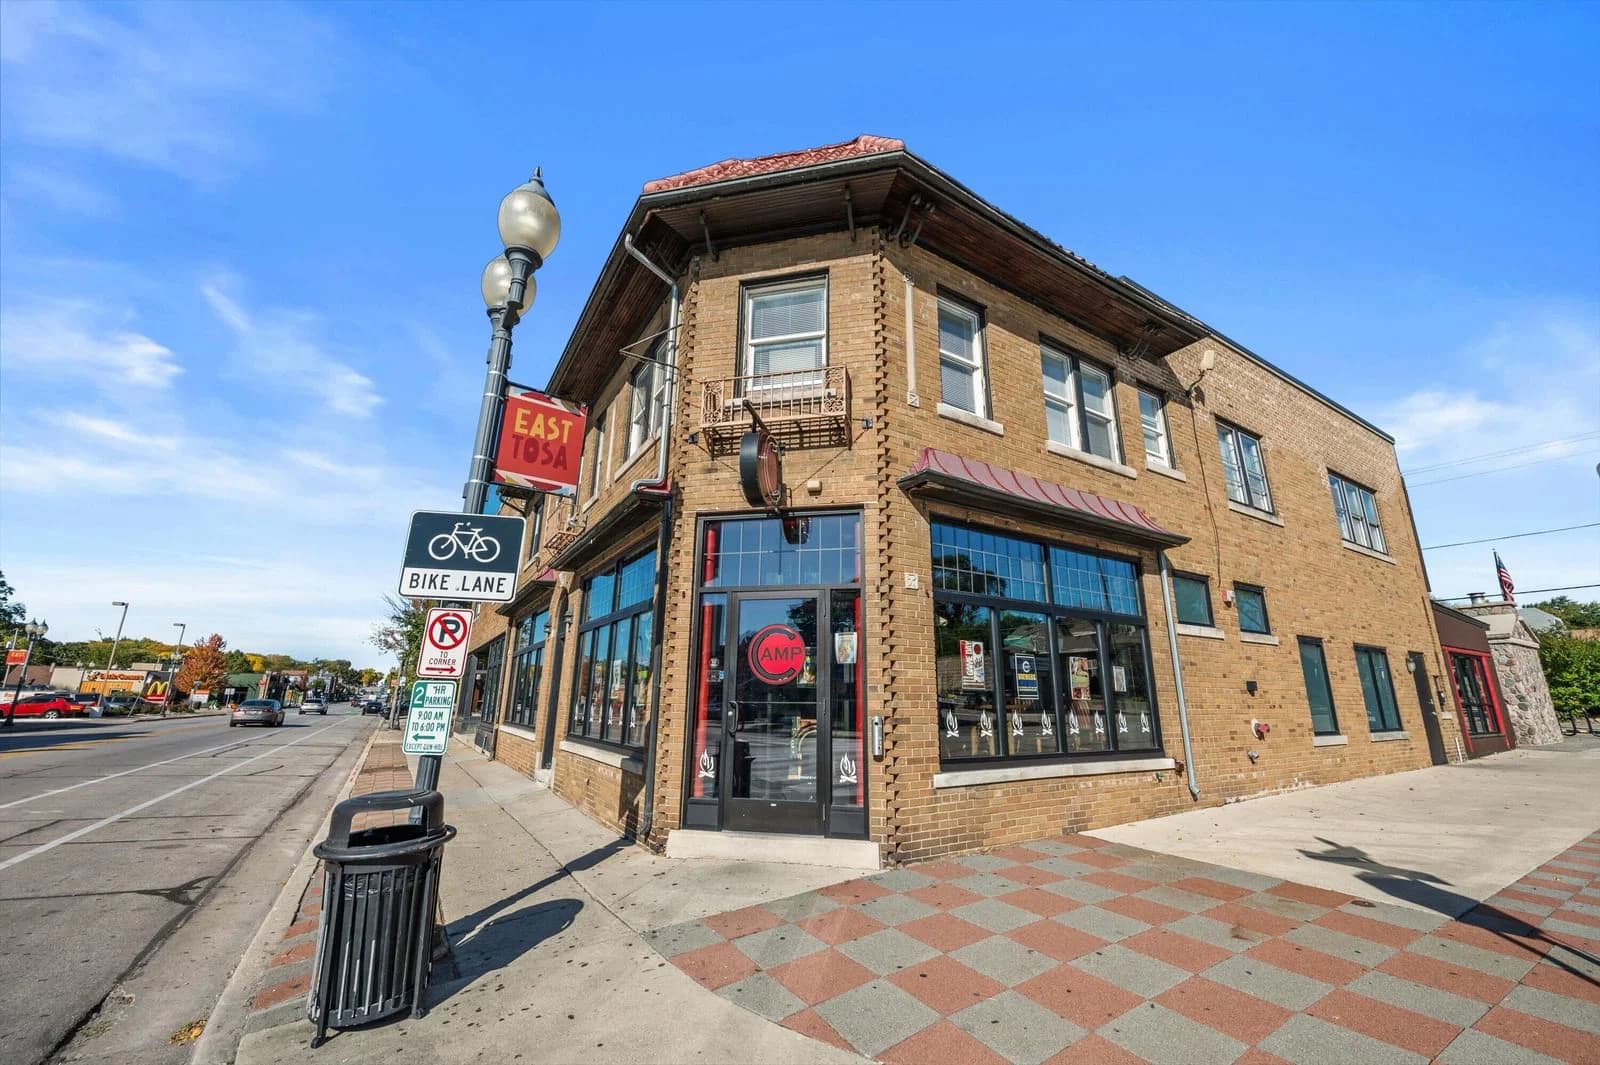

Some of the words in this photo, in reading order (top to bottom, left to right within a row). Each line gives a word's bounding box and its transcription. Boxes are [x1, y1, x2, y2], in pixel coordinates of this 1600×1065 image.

[514, 407, 573, 444] EAST
[512, 433, 568, 471] TOSA
[409, 573, 451, 590] BIKE
[461, 575, 507, 593] LANE
[439, 619, 461, 643] P
[752, 627, 803, 680] CAMP
[413, 686, 425, 704] 2
[433, 685, 447, 695] HR
[425, 696, 451, 706] PARKING
[418, 711, 432, 720] 9:00
[434, 711, 444, 720] AM
[412, 722, 419, 731] TO
[420, 722, 435, 732] 6:00
[436, 723, 446, 732] PM
